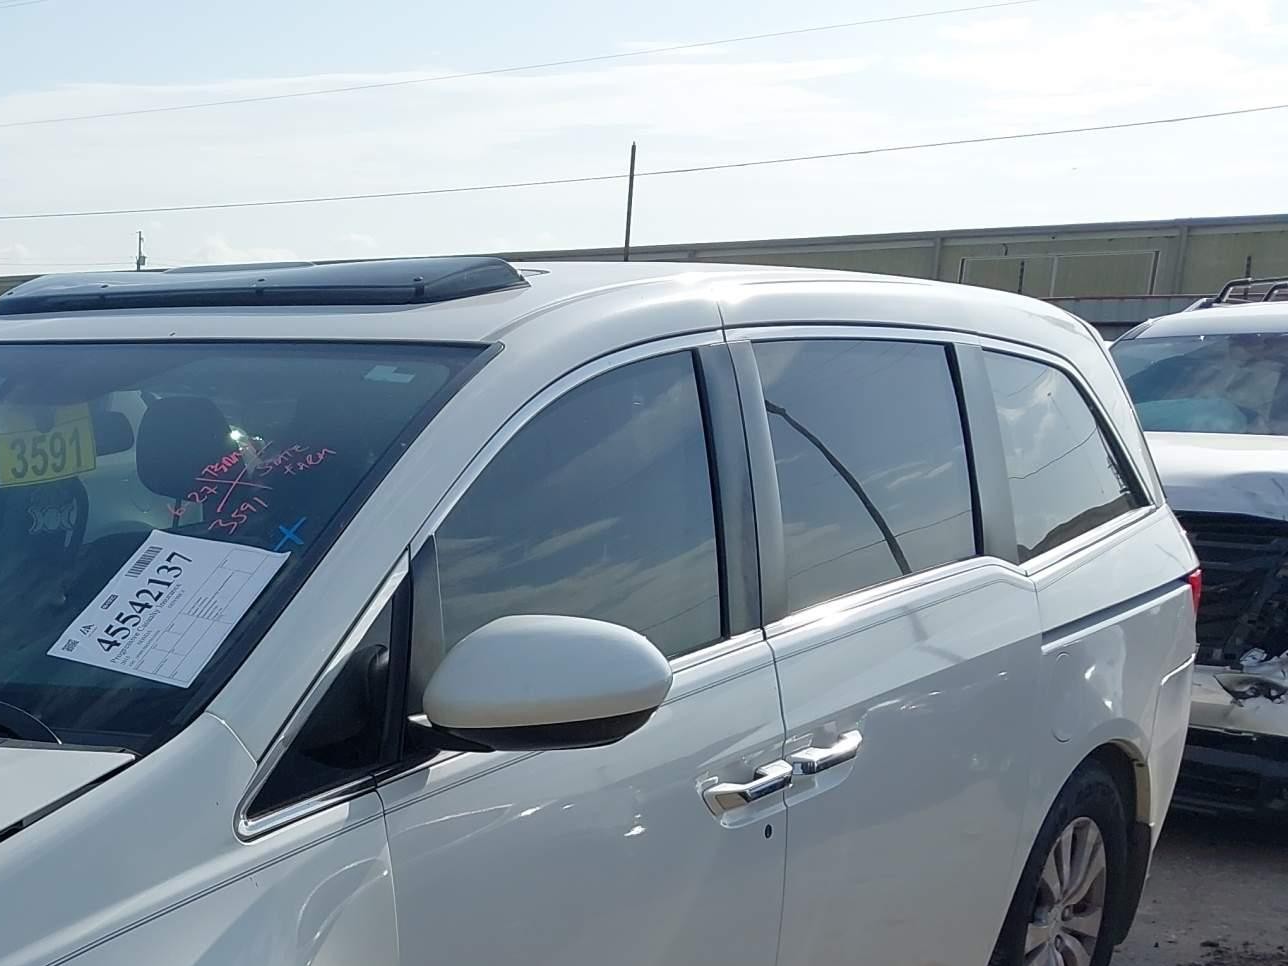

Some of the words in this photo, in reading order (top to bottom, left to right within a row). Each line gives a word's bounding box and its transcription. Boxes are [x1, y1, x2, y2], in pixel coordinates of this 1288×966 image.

[9, 427, 82, 478] 3591
[208, 496, 269, 535] 3591
[96, 551, 193, 652] 45542137
